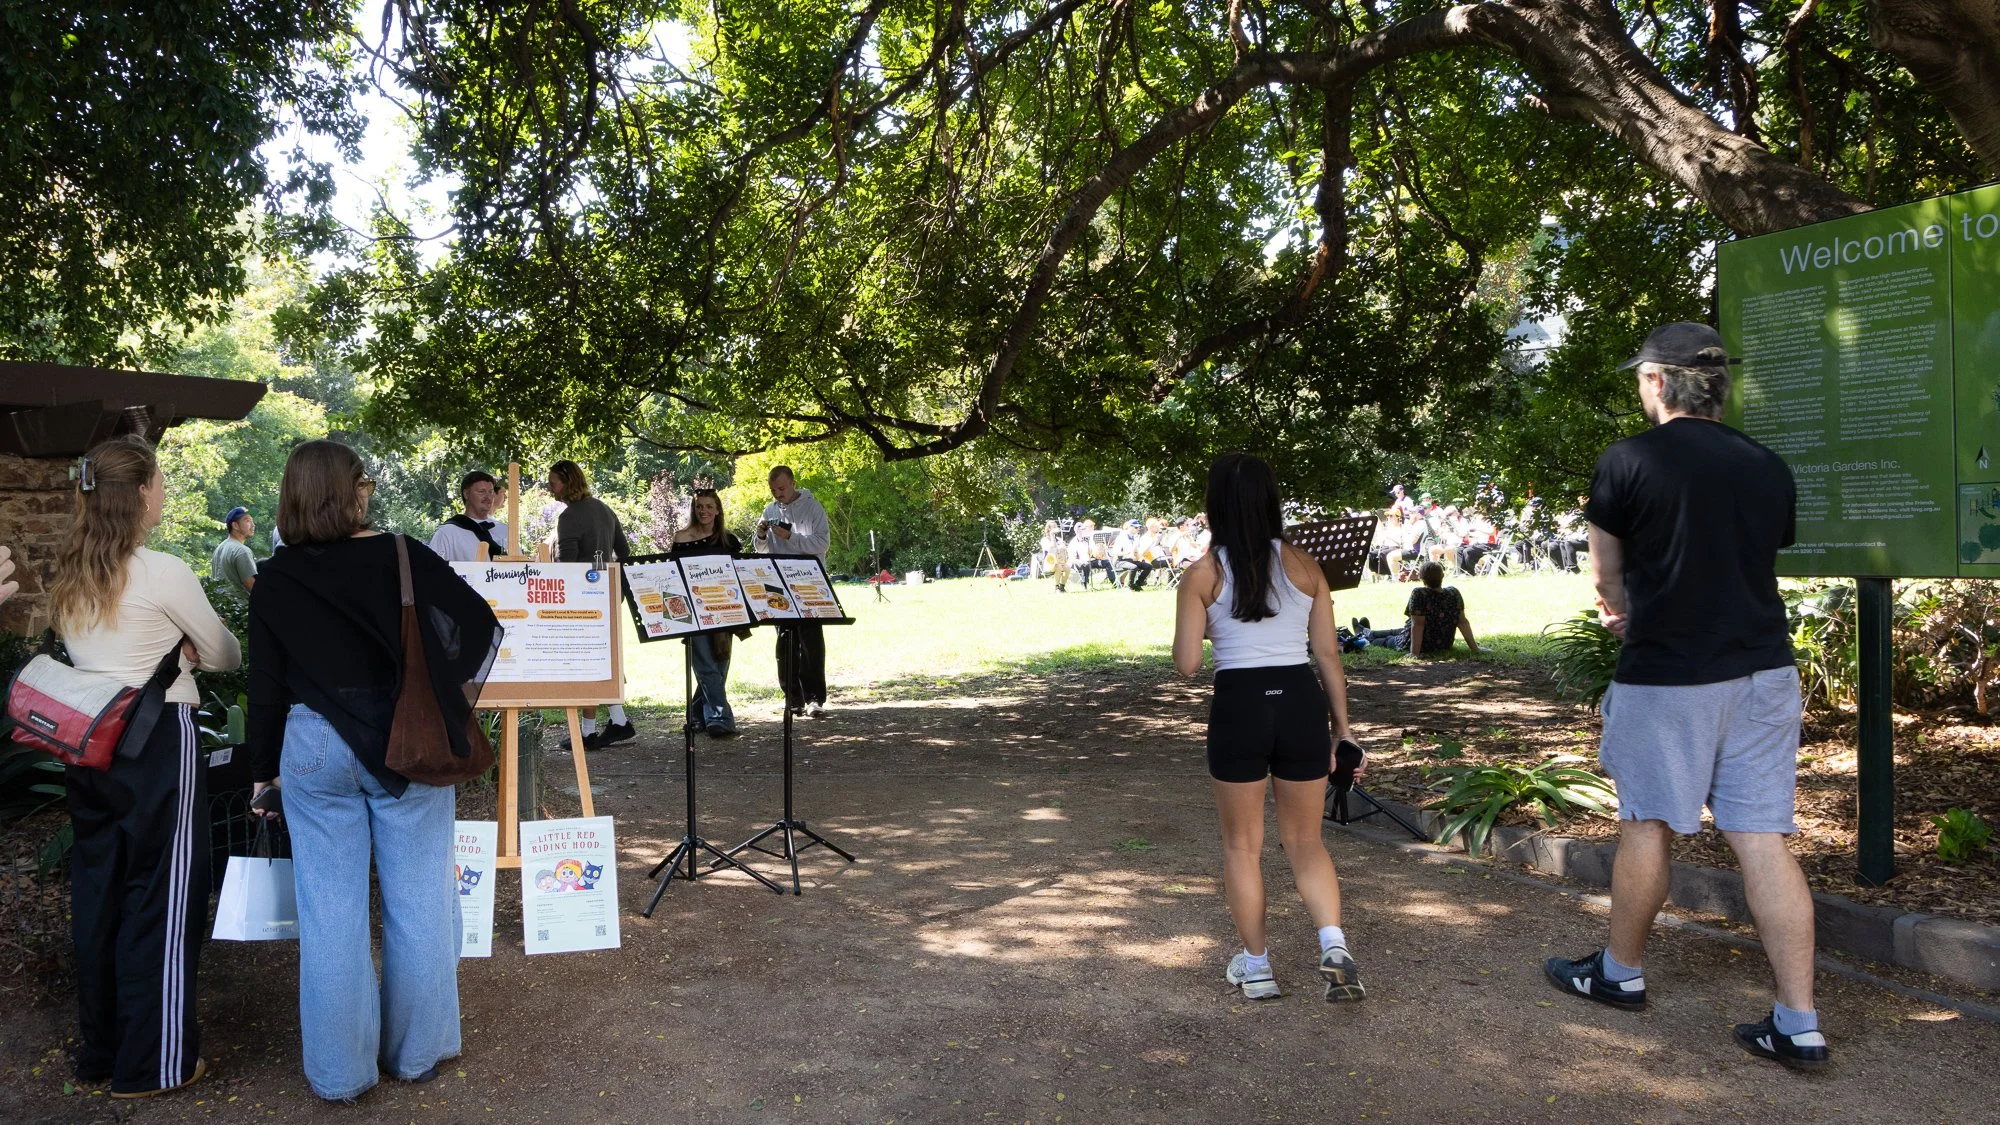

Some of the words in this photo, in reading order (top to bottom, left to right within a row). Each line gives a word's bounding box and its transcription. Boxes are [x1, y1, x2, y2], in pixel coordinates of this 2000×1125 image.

[1779, 223, 1944, 275] Welcome
[1960, 212, 2000, 241] to
[1792, 463, 1830, 474] Victoria
[1832, 460, 1878, 472] Gardens
[1880, 459, 1901, 470] Inc.
[1979, 459, 1988, 469] N
[485, 563, 541, 585] Stonnington
[528, 578, 565, 591] PICNIC
[527, 591, 566, 604] SERIES
[459, 834, 477, 844] RED
[538, 832, 571, 843] LITTLE
[577, 831, 595, 839] RED
[532, 842, 567, 854] RIDING
[573, 841, 600, 849] HOOD
